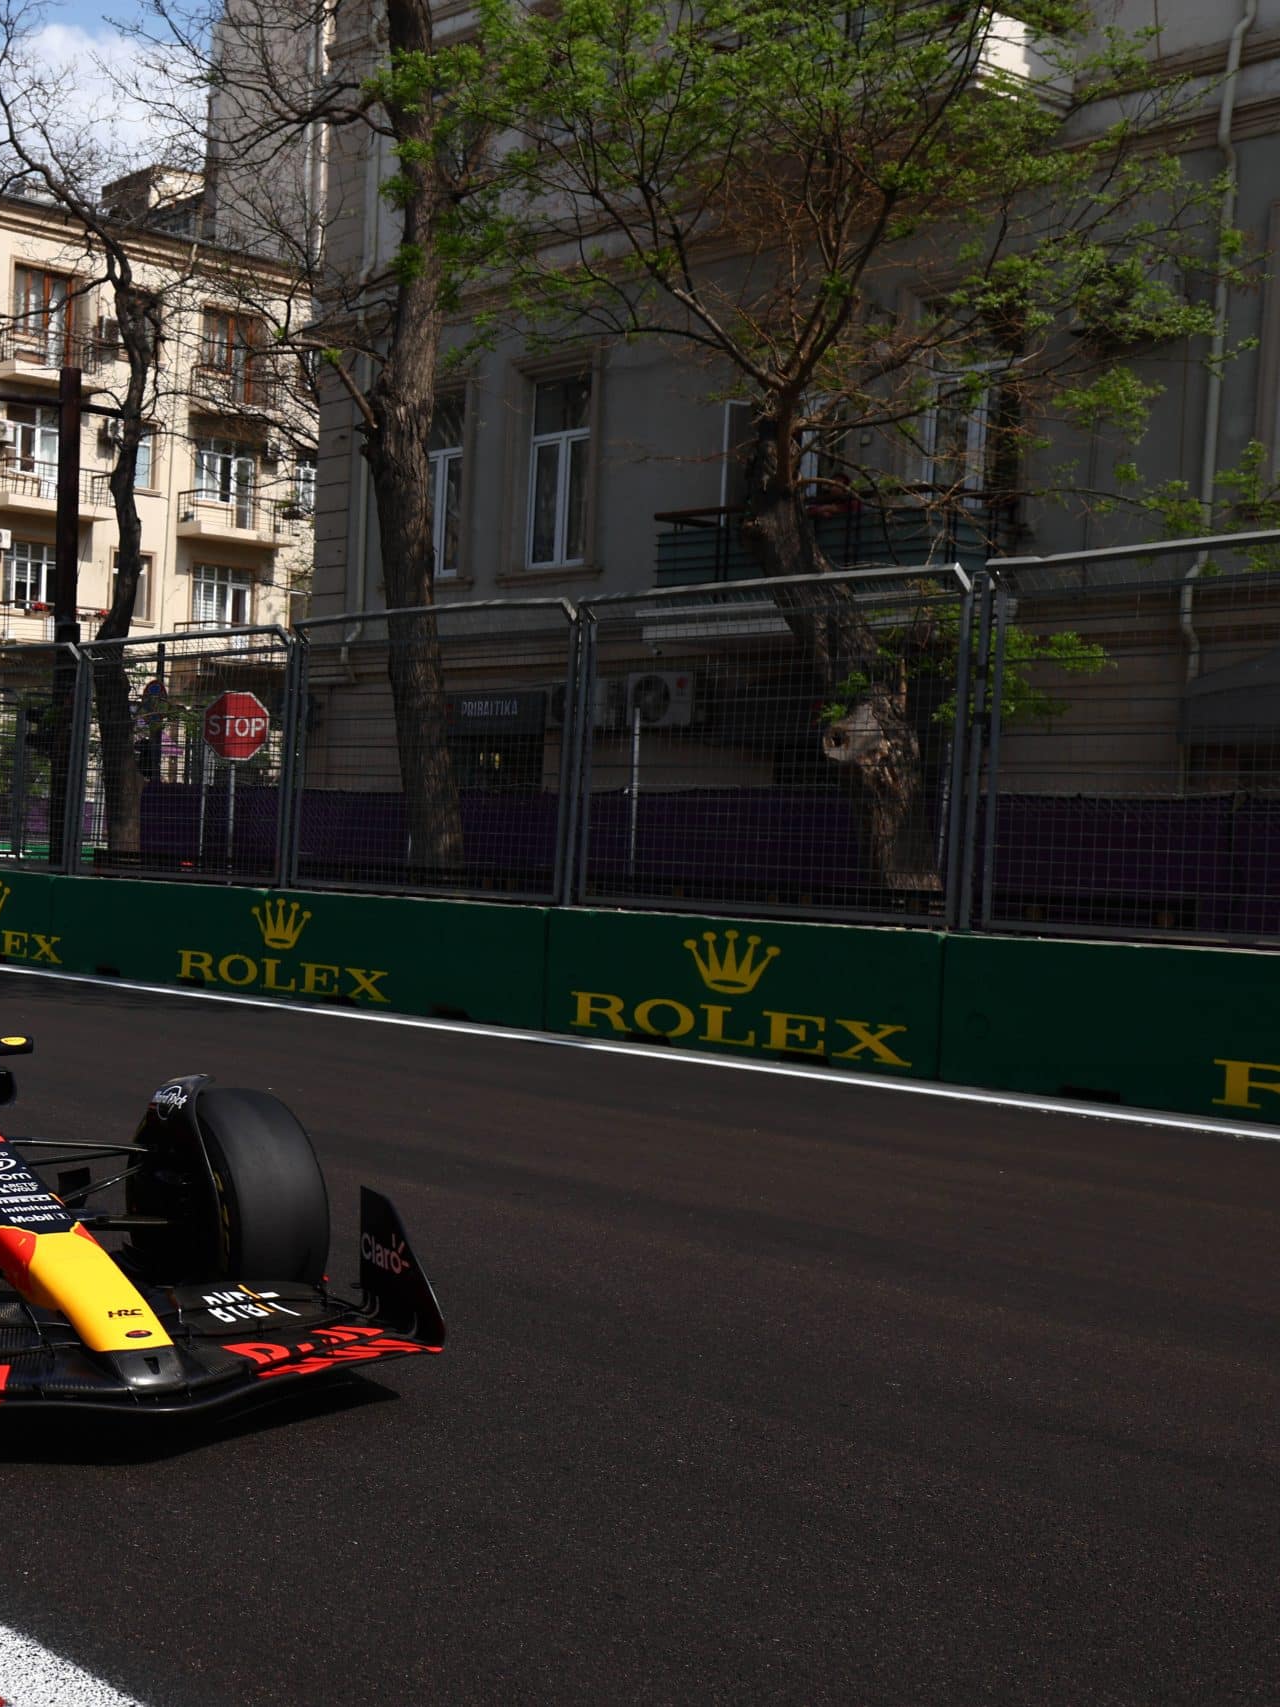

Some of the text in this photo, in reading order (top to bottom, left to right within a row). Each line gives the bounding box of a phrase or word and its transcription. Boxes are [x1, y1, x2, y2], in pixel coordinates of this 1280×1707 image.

[208, 715, 265, 737] STOP
[176, 949, 391, 1004] ROLEX
[570, 991, 912, 1067] ROLEX
[9, 1213, 54, 1224] Mobil
[362, 1232, 403, 1274] Claro
[107, 1308, 144, 1318] HRC
